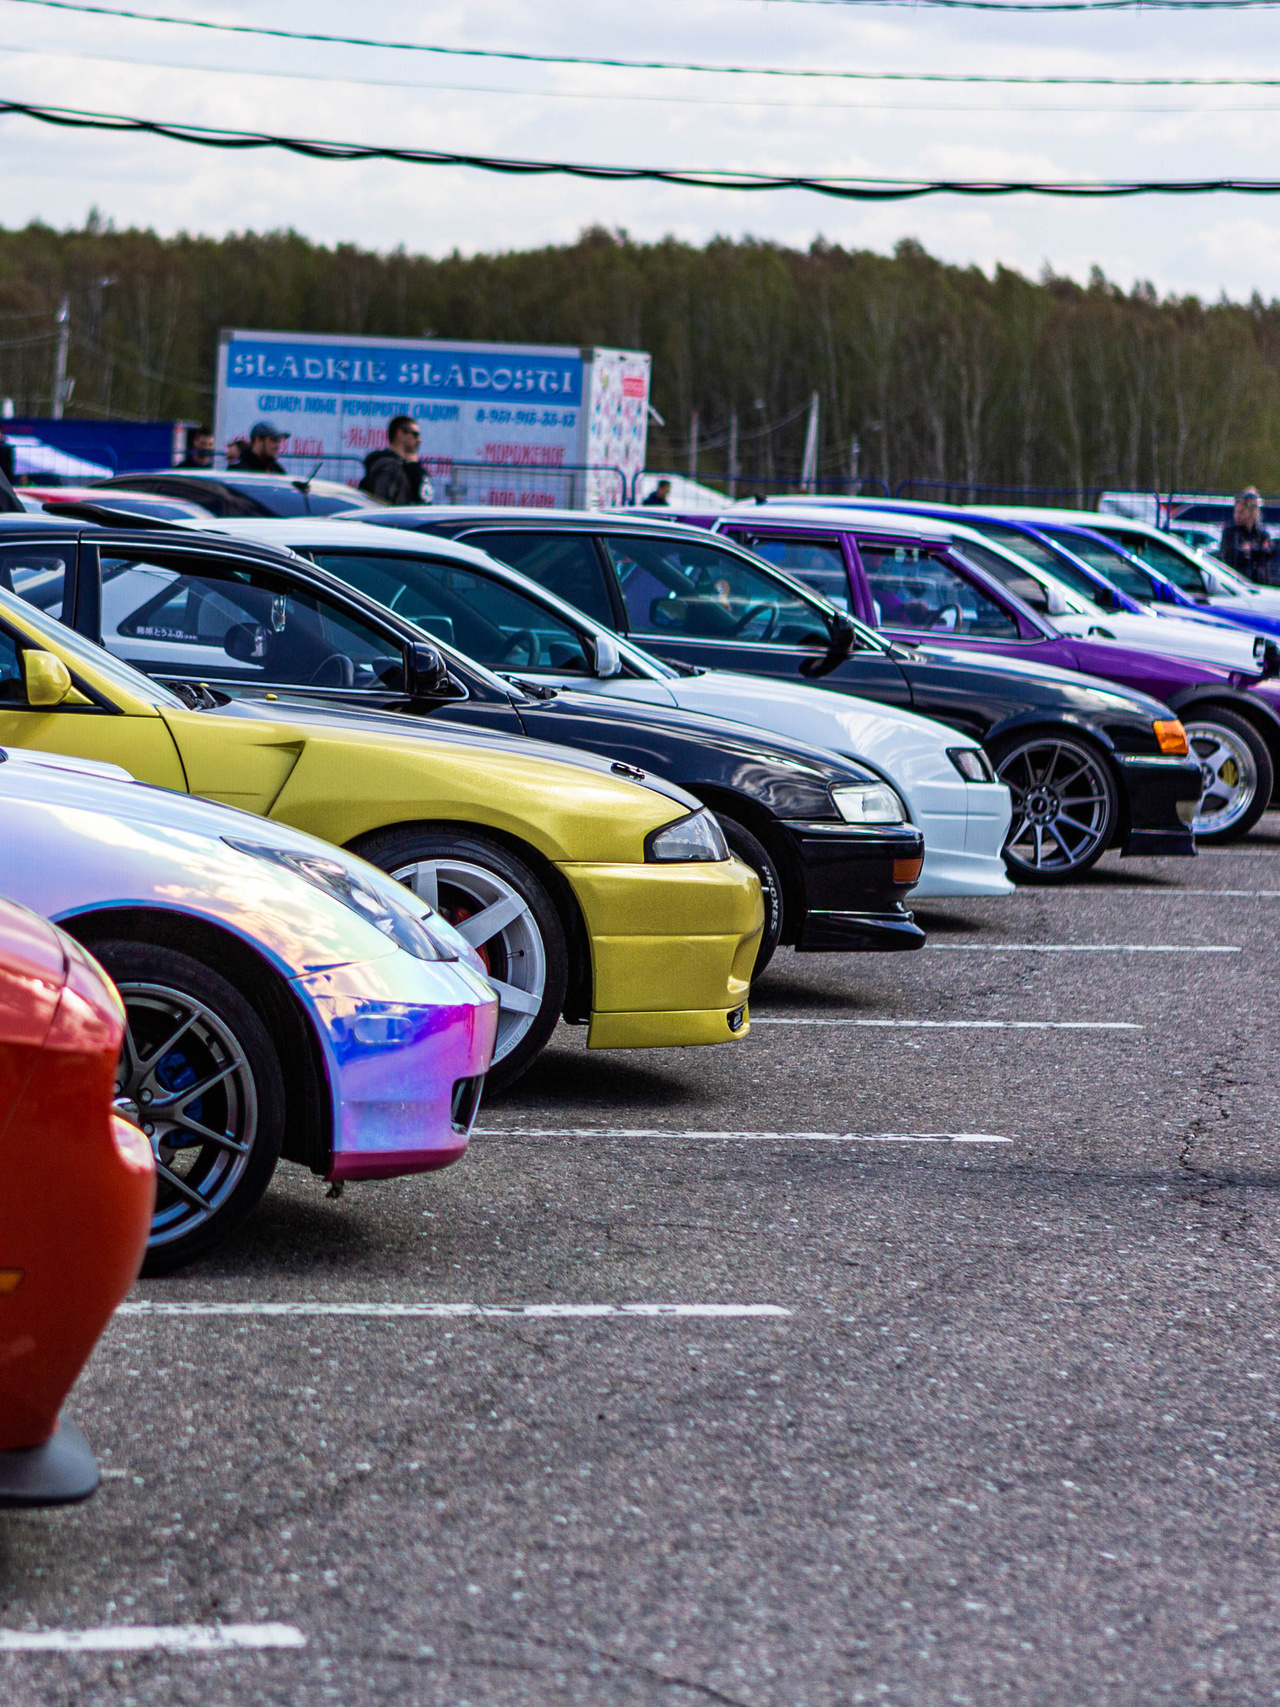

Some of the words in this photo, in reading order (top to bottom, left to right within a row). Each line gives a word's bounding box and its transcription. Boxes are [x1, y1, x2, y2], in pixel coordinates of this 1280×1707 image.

[233, 353, 389, 384] SLADKIE
[398, 362, 574, 394] SLADOSTI
[761, 865, 779, 931] PROXES
